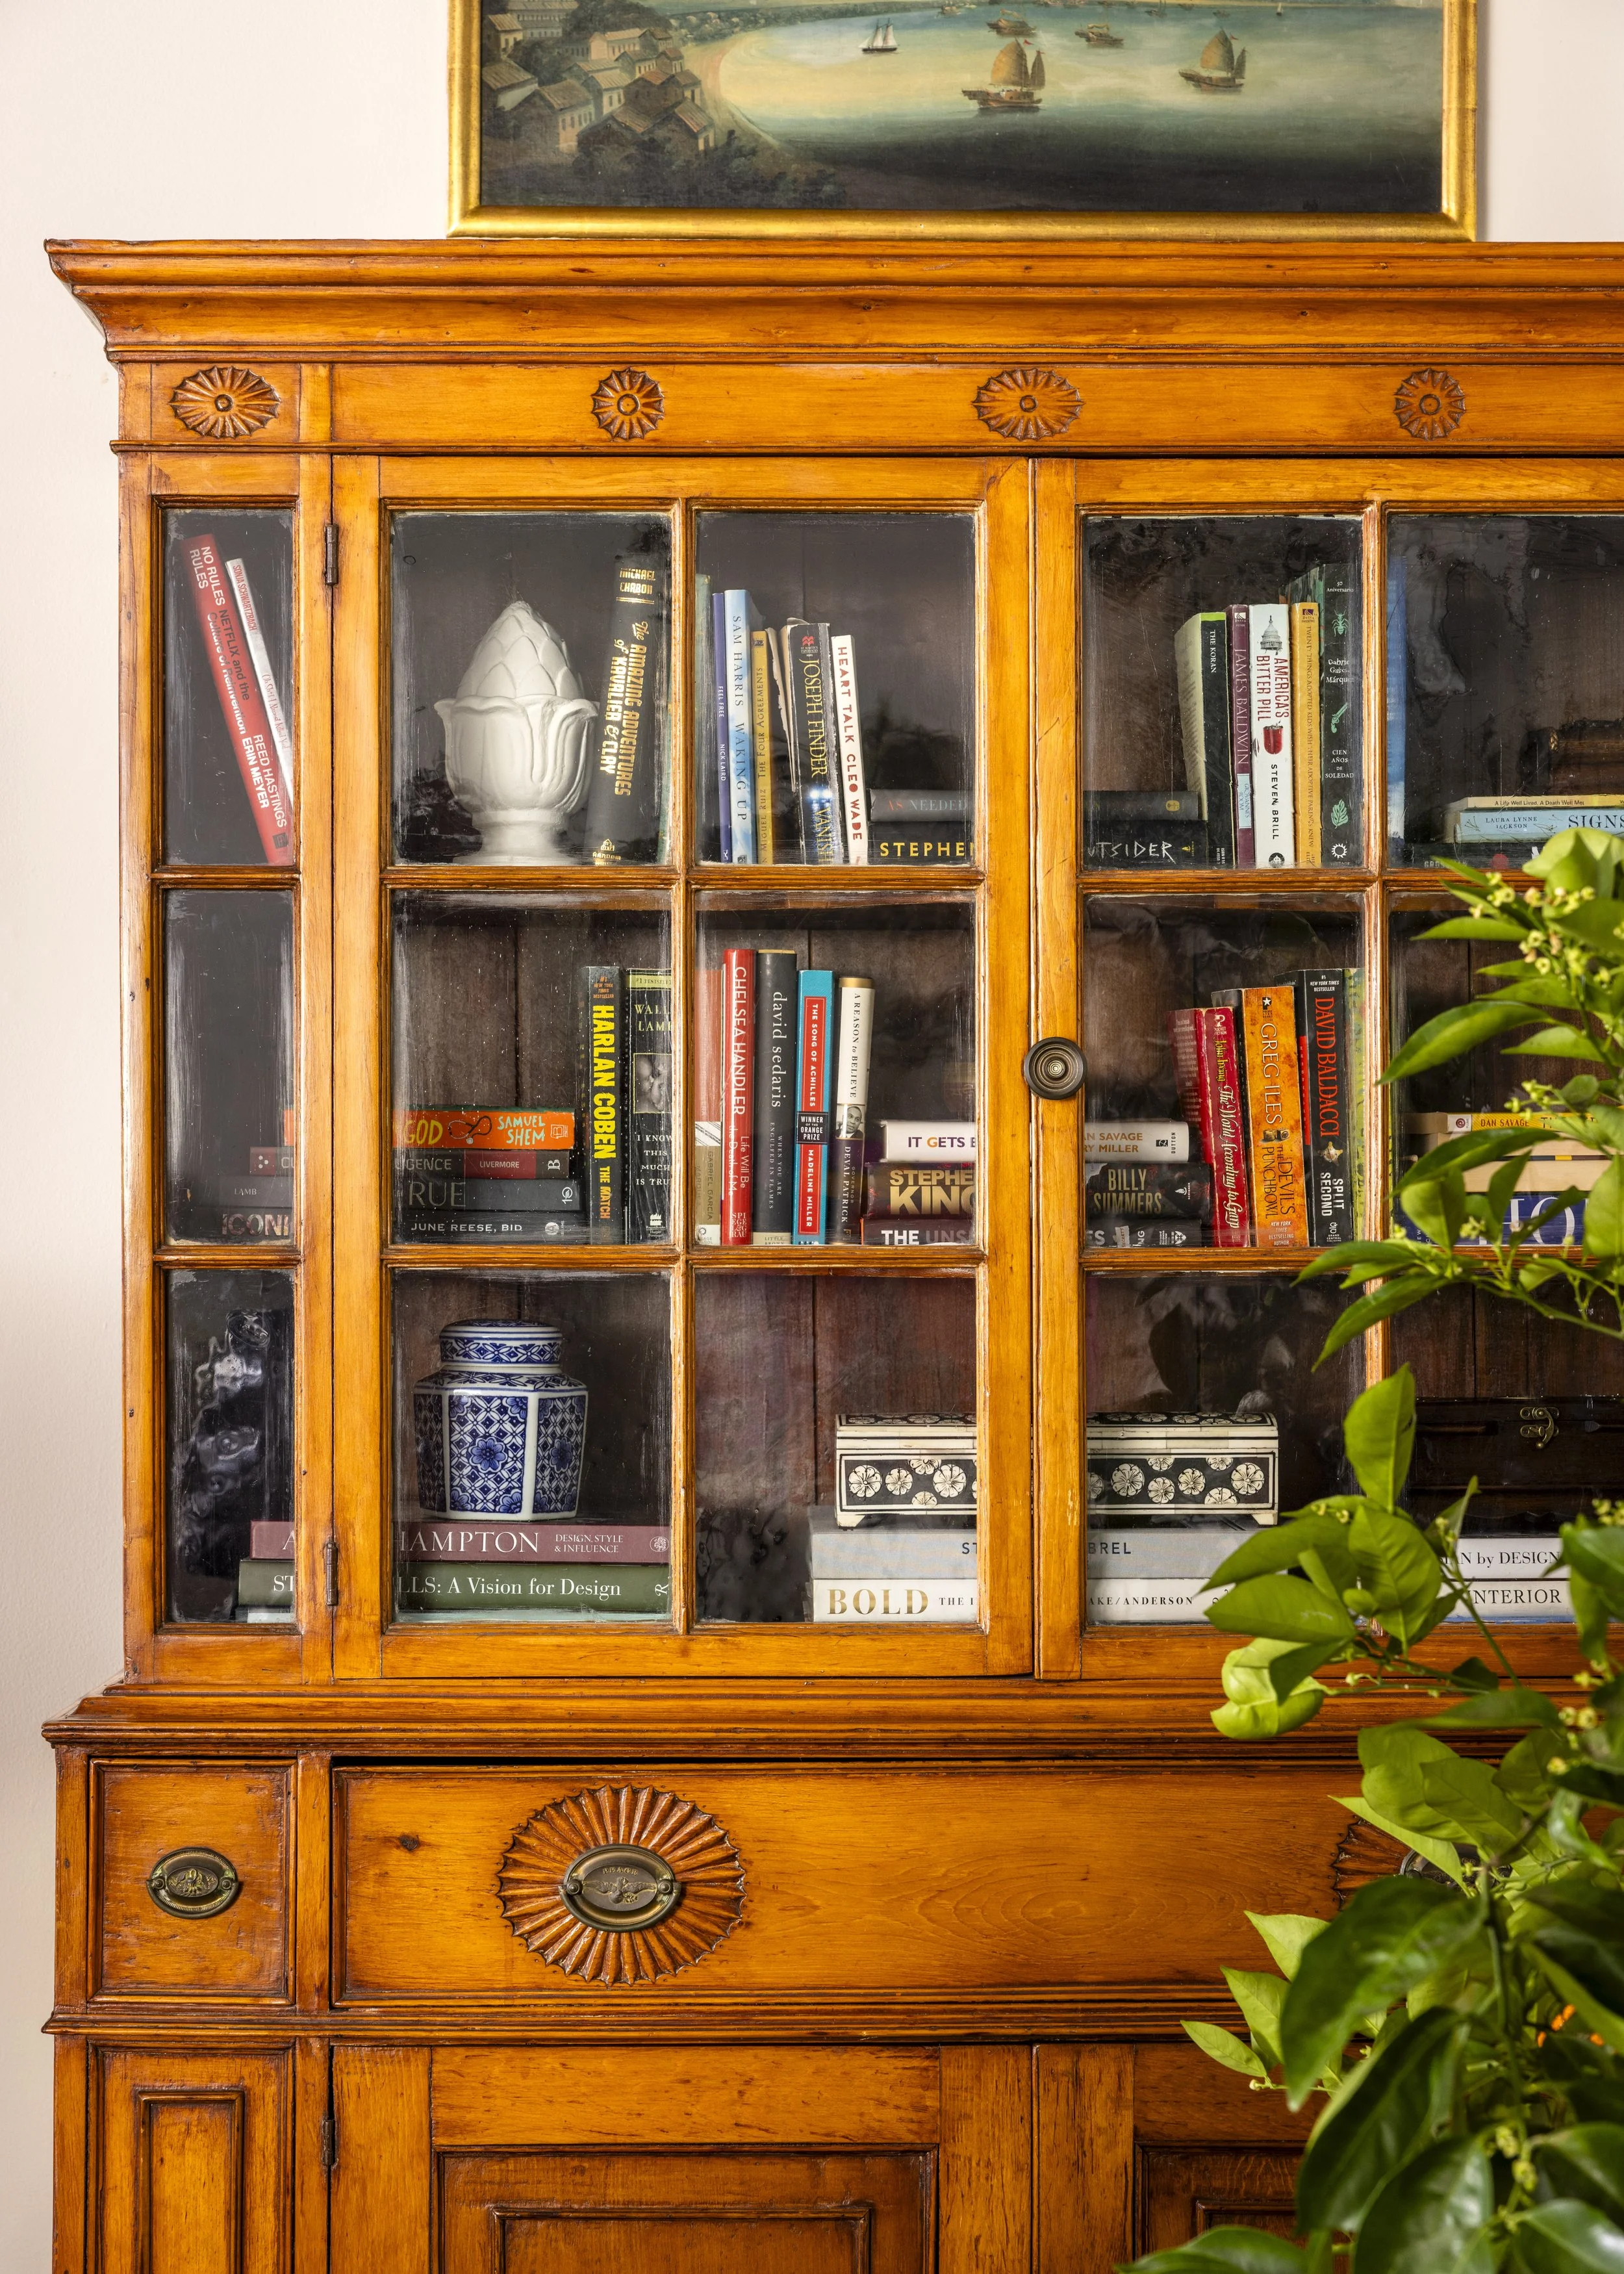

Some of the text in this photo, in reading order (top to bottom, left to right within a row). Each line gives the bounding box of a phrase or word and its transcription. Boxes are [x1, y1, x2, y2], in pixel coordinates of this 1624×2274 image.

[190, 549, 209, 589] RULES
[201, 546, 225, 606] NO RULES
[620, 568, 655, 581] MICHAEL
[620, 582, 652, 594] CHABON
[234, 565, 257, 631] SONJA SCHWARTZBACH
[208, 613, 247, 735] Culture of Reinvention
[219, 609, 249, 701] NETFLIX and the
[615, 620, 649, 796] The AMAZING ADVENTURES
[1234, 650, 1249, 764] JAMES BALDWIN
[1256, 656, 1271, 721] BITTER PILL
[1274, 658, 1289, 718] AMERICA'S
[733, 616, 746, 821] SAM HARRIS WAKING UP
[799, 659, 828, 778] JOSEPH FINDER
[838, 646, 862, 840] HEART TALK CLEO WADE
[242, 737, 270, 809] ERIN MEYER
[253, 734, 270, 766] REED
[262, 768, 286, 828] HASTINGS
[1271, 764, 1279, 806] STEVEN
[733, 966, 746, 1116] CHELSEA HANDLER
[852, 1003, 861, 1043] REASON
[771, 991, 787, 1107] david sedaris
[811, 1051, 817, 1062] OF
[1213, 1038, 1228, 1082] John Irving
[1261, 1023, 1280, 1078] GREG
[1315, 997, 1339, 1137] DAVID BALDACCI
[592, 1005, 616, 1159] HARLAN COBEN
[1217, 1085, 1236, 1105] The
[497, 1116, 546, 1131] SAMUEL
[1219, 1105, 1238, 1138] World
[1264, 1084, 1282, 1124] ILES
[1500, 1118, 1529, 1127] SAVAGE
[403, 1119, 444, 1145] GOD
[506, 1129, 545, 1146] SHEM
[908, 1137, 922, 1147] IT
[927, 1136, 965, 1148] GETS
[740, 1136, 750, 1188] Life Will Be
[1108, 1169, 1147, 1191] BILLY
[1219, 1135, 1239, 1189] According
[1262, 1147, 1278, 1219] PUNCHBOWL
[409, 1182, 466, 1207] RUE
[600, 1166, 611, 1219] THE MATCH
[841, 1180, 850, 1223] PATRICK
[1094, 1192, 1161, 1215] SUMMERS
[1227, 1190, 1239, 1203] to
[1278, 1161, 1296, 1215] DEVIL'S
[1320, 1172, 1332, 1216] SECOND
[1332, 1178, 1344, 1209] SPLIT
[411, 1223, 446, 1232] JUNE
[450, 1224, 497, 1233] REESE,
[1223, 1201, 1243, 1228] Garp
[1477, 1552, 1494, 1568] by
[1498, 1551, 1560, 1565] DESIGN
[448, 1577, 461, 1594] A
[466, 1577, 522, 1594] Vision
[529, 1578, 554, 1594] for
[559, 1578, 622, 1602] Design
[827, 1589, 929, 1615] BOLD
[939, 1597, 964, 1605] THE
[602, 1866, 638, 1876] PEACE
